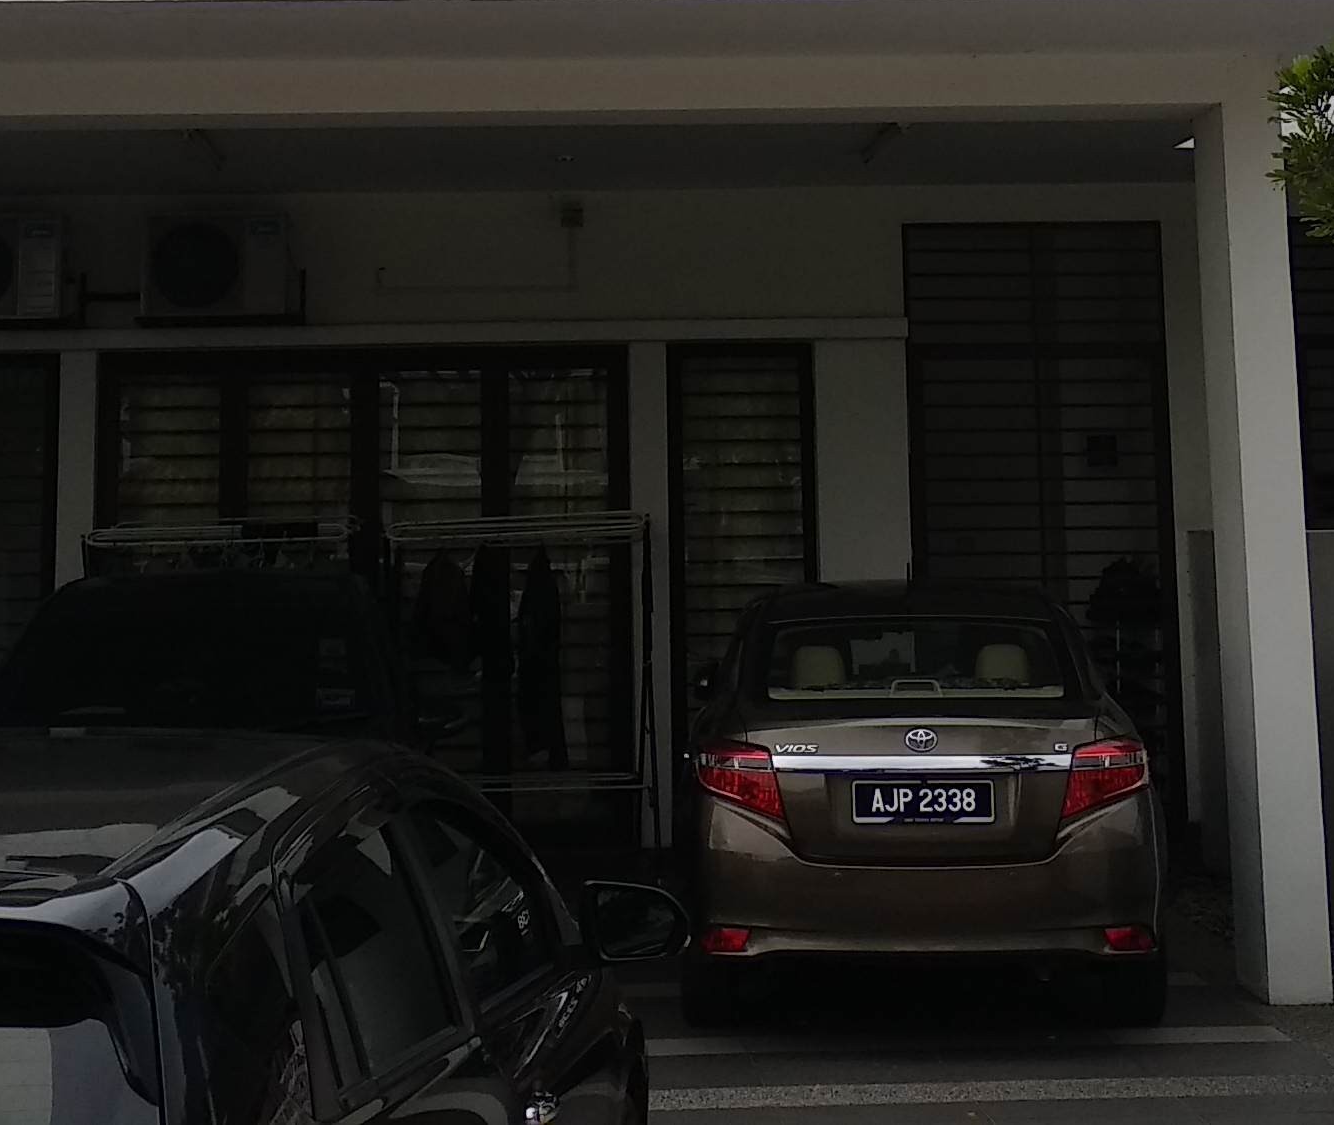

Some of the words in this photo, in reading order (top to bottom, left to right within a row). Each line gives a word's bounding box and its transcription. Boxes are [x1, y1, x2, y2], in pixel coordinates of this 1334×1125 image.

[775, 744, 819, 753] VIOS
[1054, 743, 1068, 751] G
[871, 788, 913, 813] AJP
[918, 788, 976, 812] 2338
